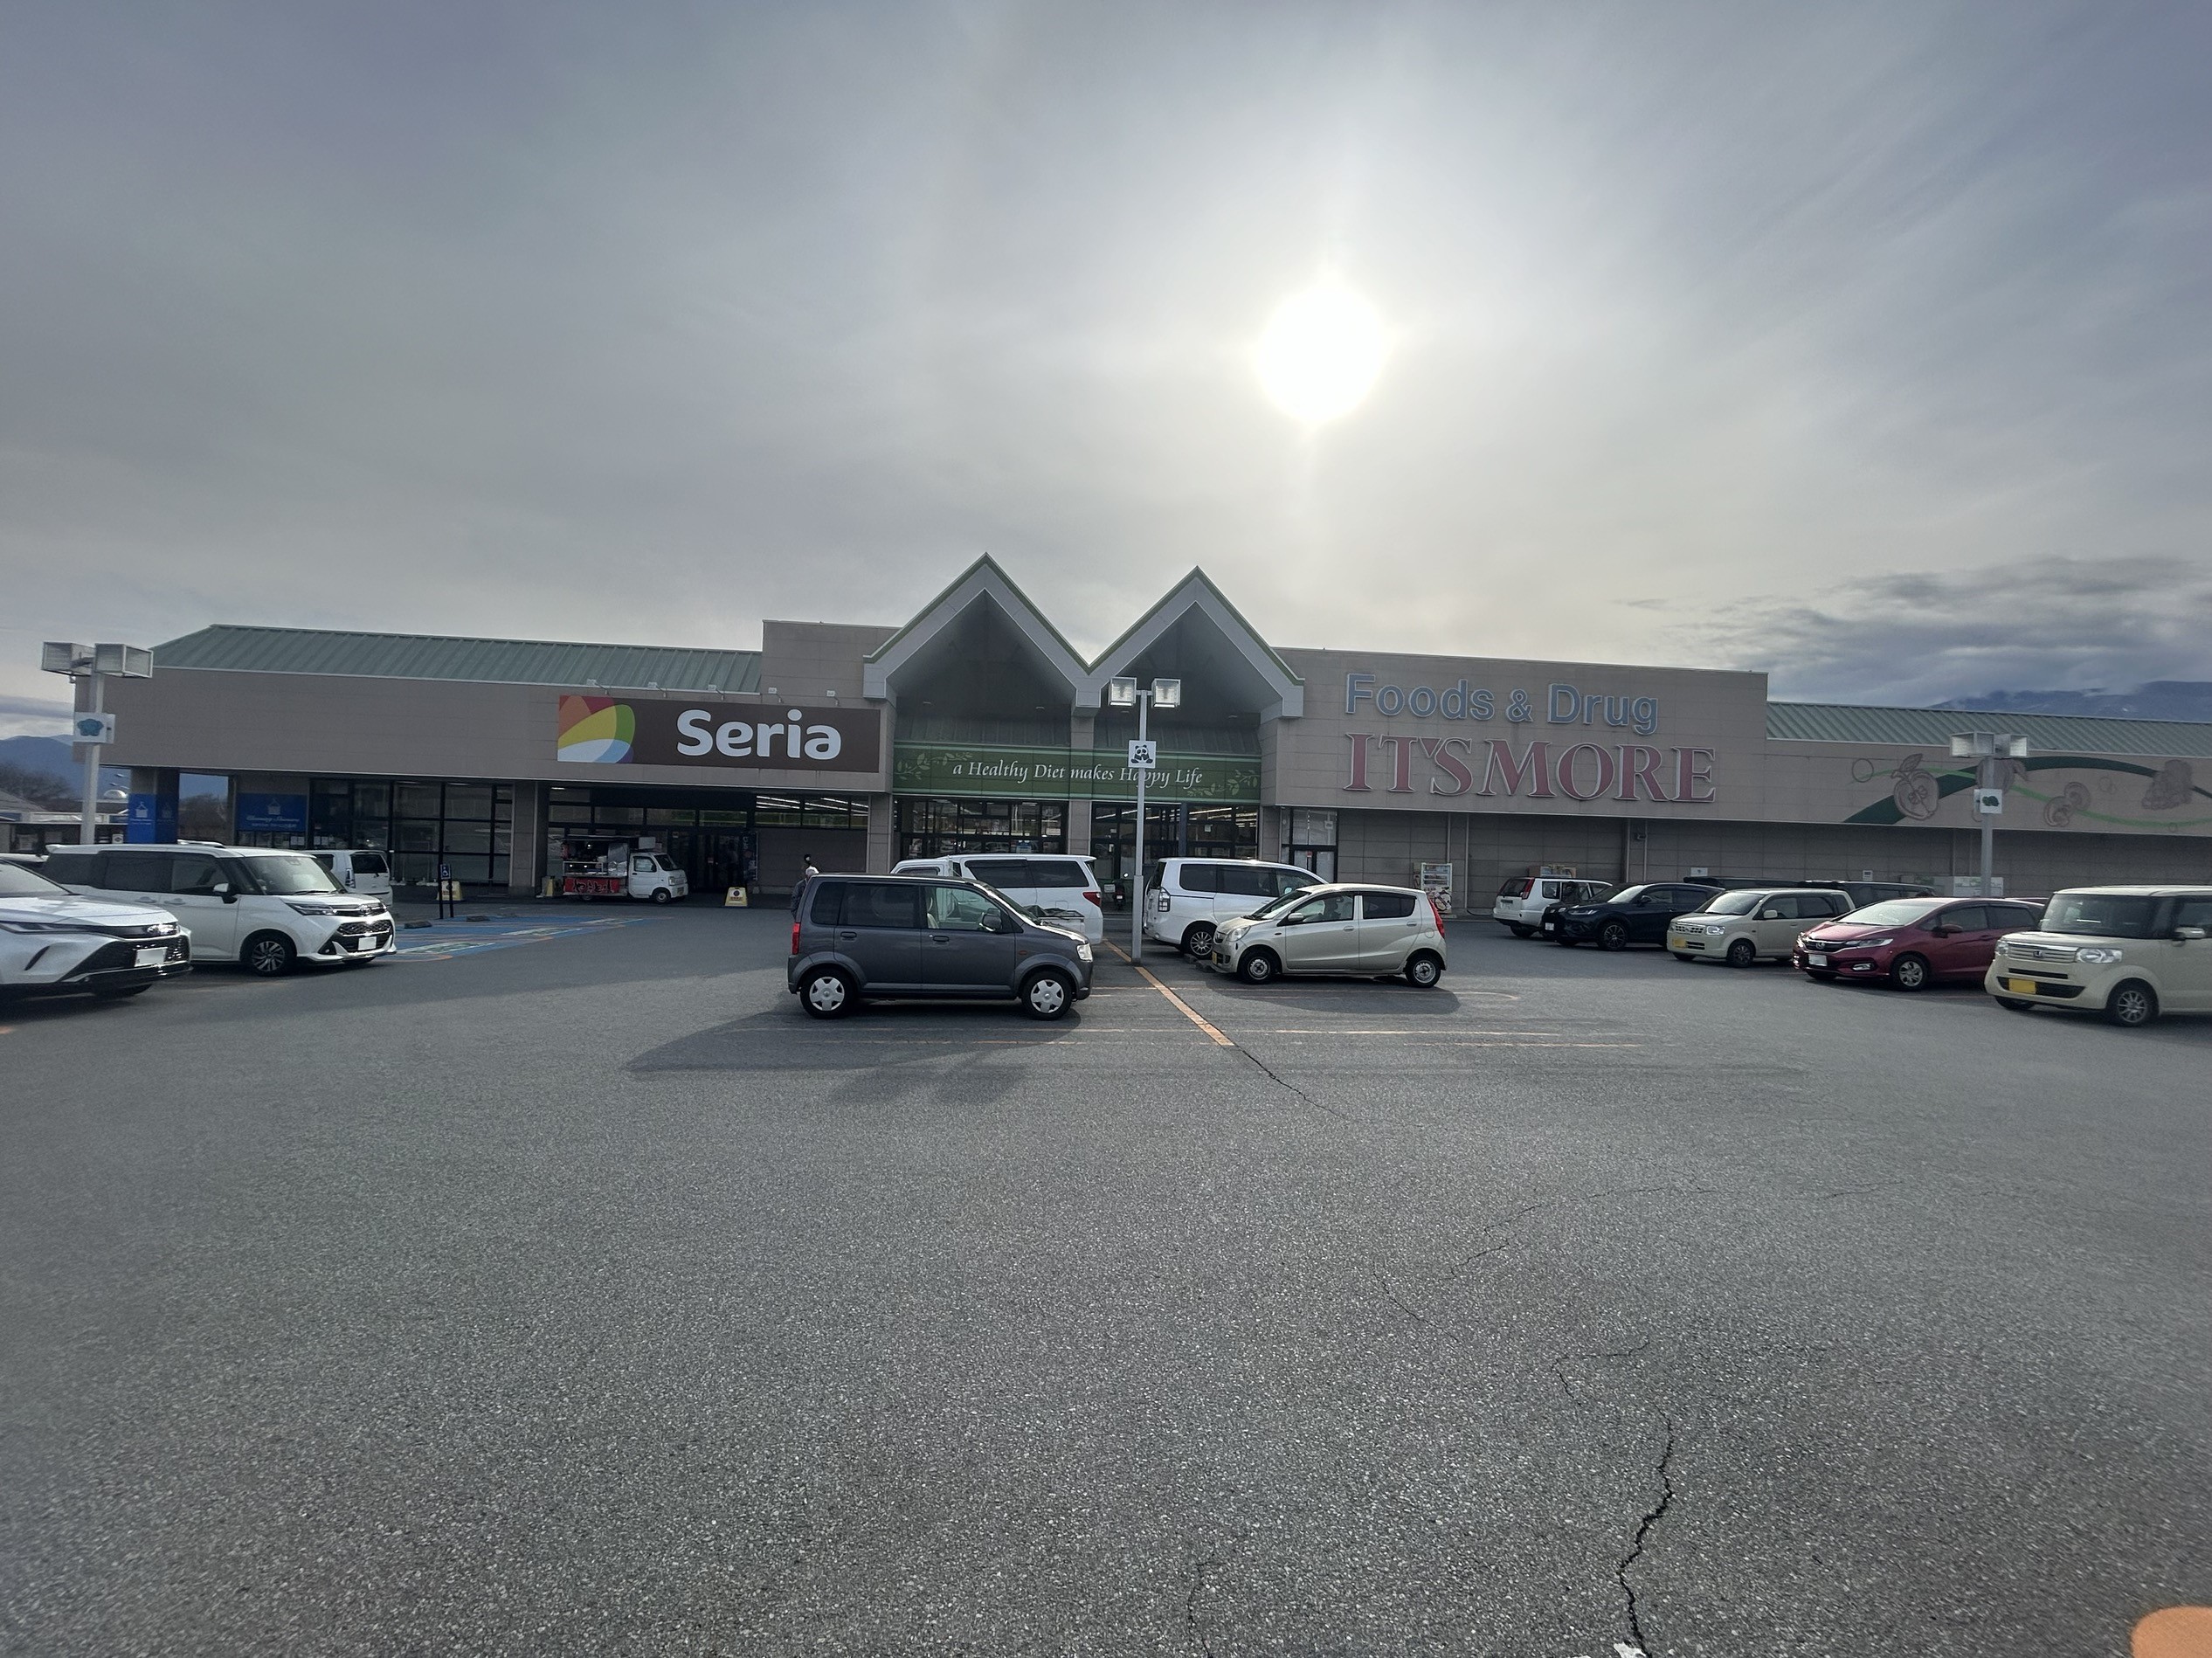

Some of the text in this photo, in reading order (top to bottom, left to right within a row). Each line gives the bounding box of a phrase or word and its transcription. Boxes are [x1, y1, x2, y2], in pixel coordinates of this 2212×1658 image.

[1345, 674, 1658, 736] Foods & Drug
[676, 708, 842, 760] Seria
[952, 764, 962, 775] a
[968, 759, 1028, 784] Healthy
[1033, 763, 1066, 779] Diet
[1070, 763, 1115, 781] makes
[1175, 767, 1203, 790] Life
